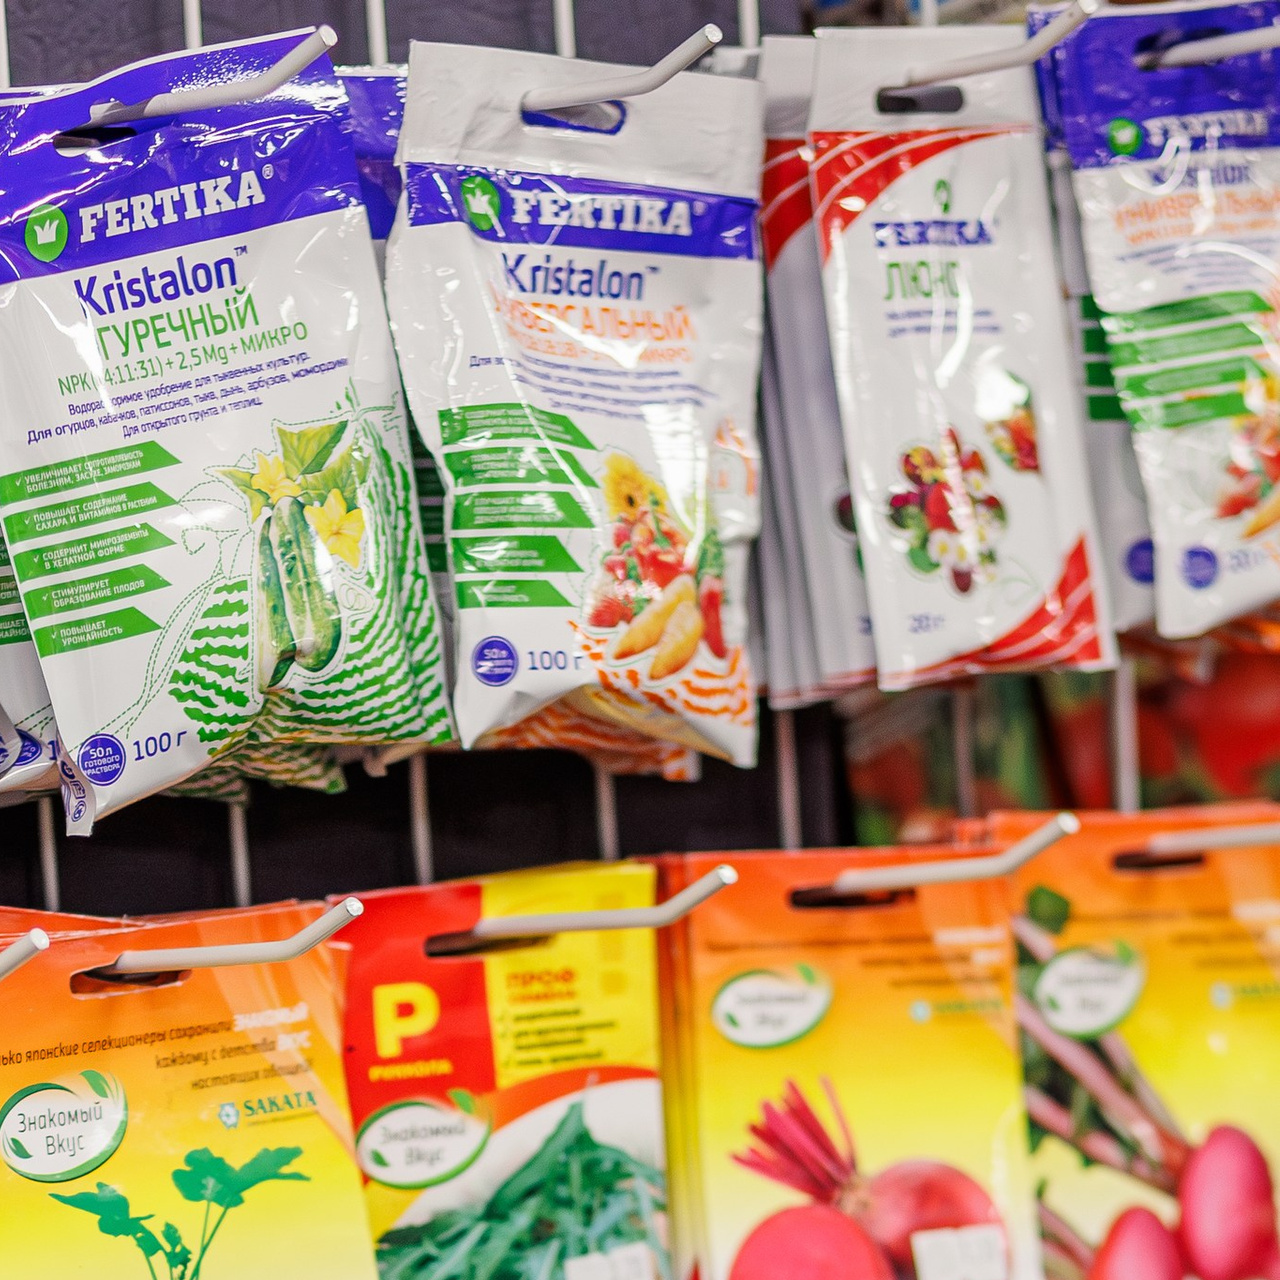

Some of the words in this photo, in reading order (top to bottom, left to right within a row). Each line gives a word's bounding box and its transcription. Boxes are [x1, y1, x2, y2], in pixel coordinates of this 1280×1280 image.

[510, 188, 693, 236] FERTIKA
[27, 426, 53, 446] Для
[25, 463, 83, 485] УВЕЛИЧИВАЕТ
[62, 624, 123, 647] УРОЖАЙНОСТЬ
[526, 650, 568, 671] 100
[133, 732, 171, 762] 100
[371, 980, 441, 1059] Р
[25, 1042, 80, 1064] японские
[81, 1028, 168, 1055] селекционеры
[17, 1101, 104, 1134] Знакомый
[243, 1089, 318, 1118] SAKATA
[45, 1133, 86, 1158] Вкус
